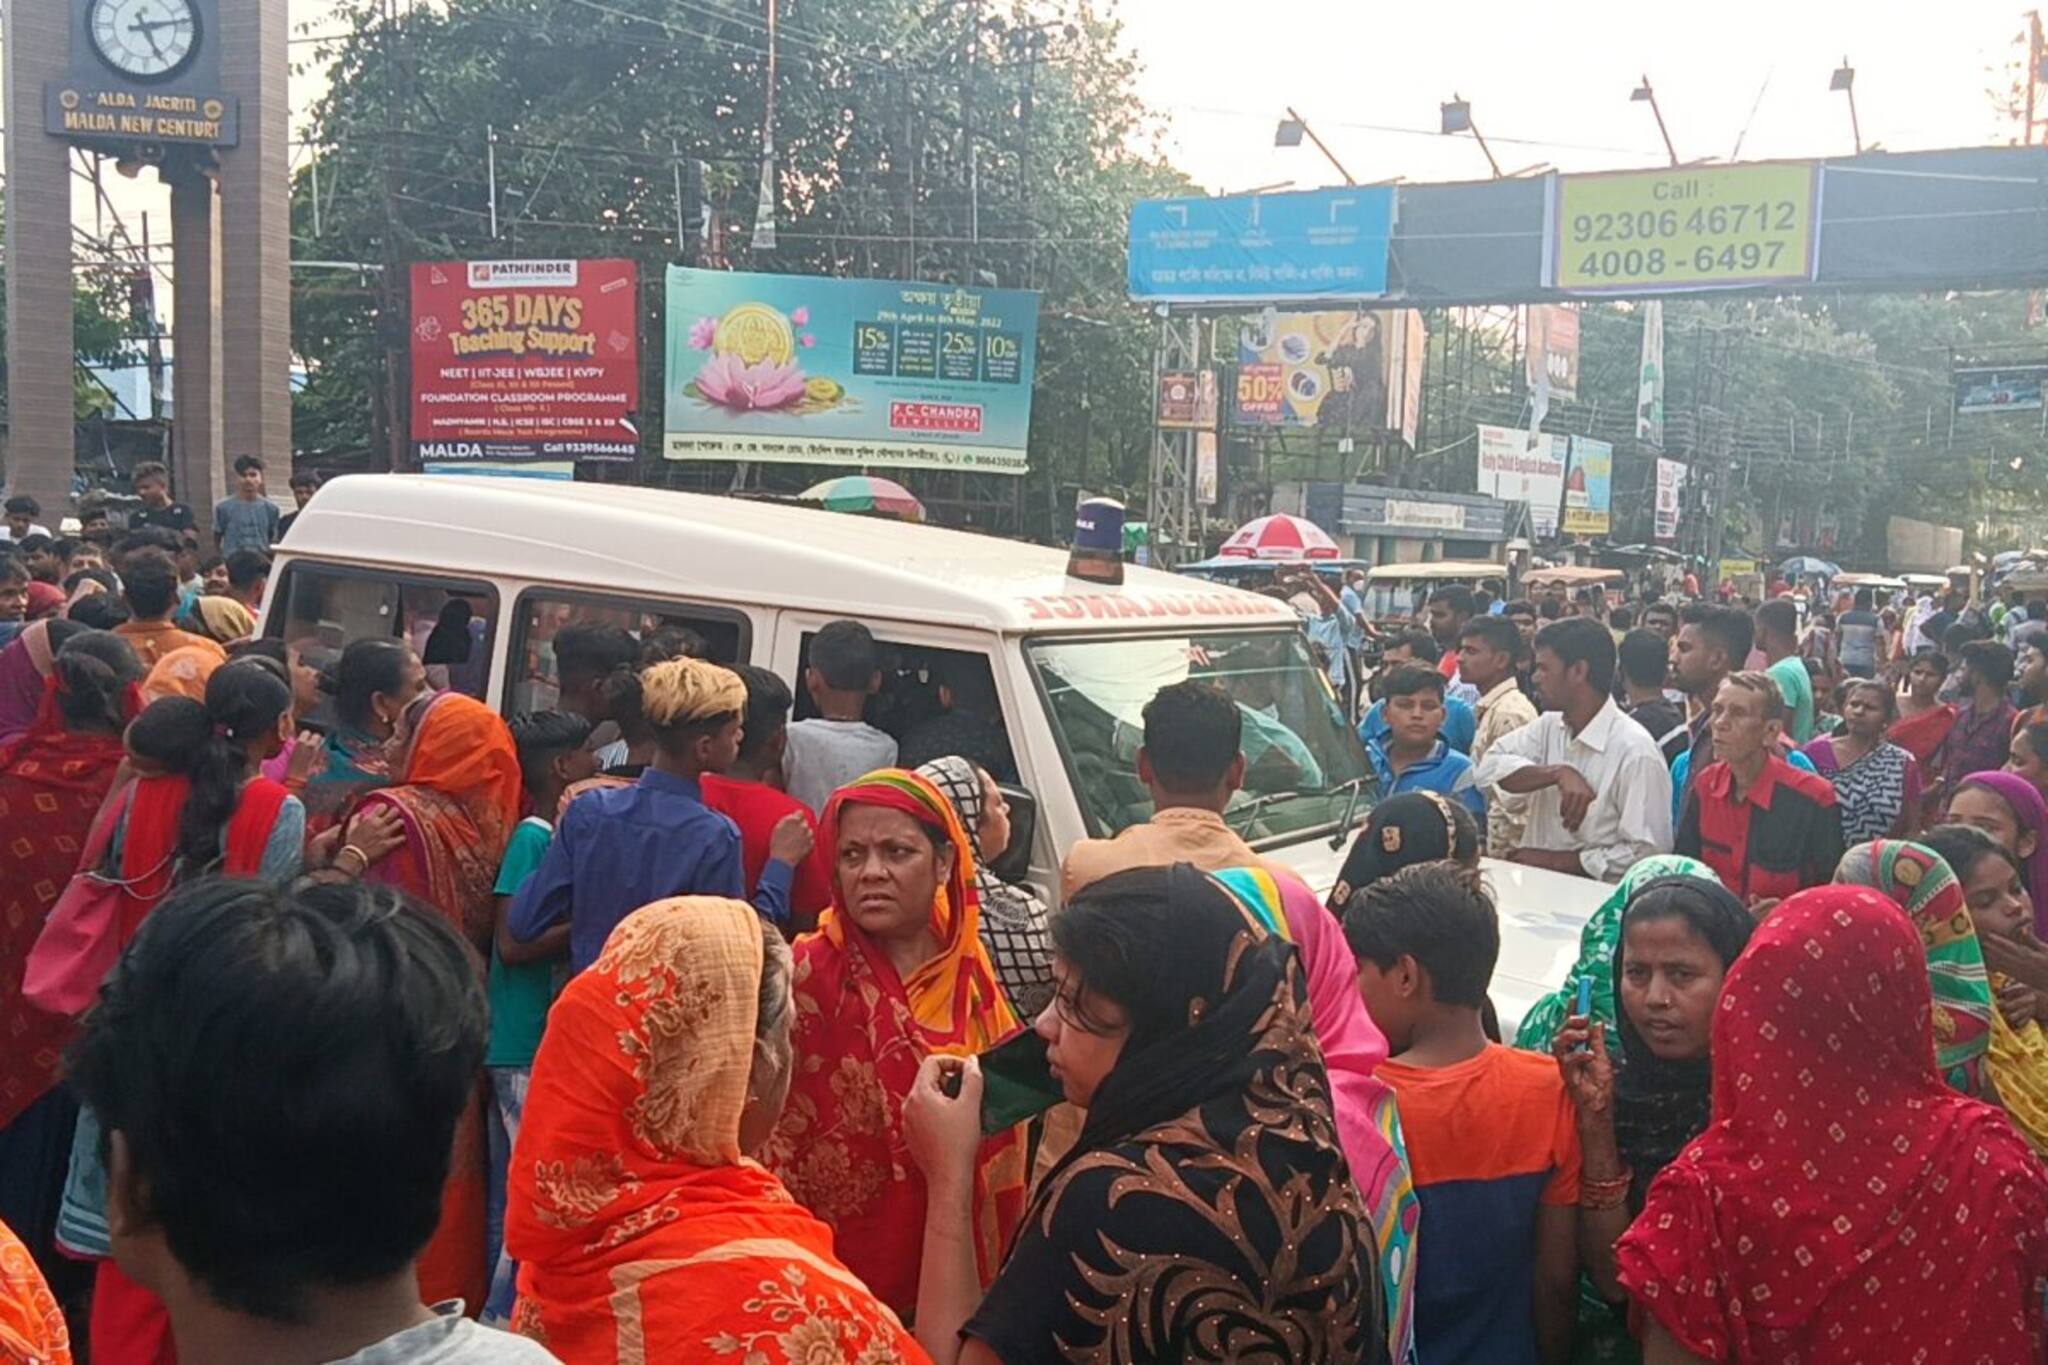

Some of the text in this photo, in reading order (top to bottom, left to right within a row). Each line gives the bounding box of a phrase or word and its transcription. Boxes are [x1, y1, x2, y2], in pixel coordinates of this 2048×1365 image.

[65, 111, 116, 132] MALDA
[120, 115, 153, 134] NEW
[1653, 180, 1699, 201] Call
[492, 263, 572, 275] PATHFINDER
[1578, 249, 1666, 277] 4008
[1693, 241, 1785, 272] 6497
[461, 294, 584, 330] 365 DAYS
[448, 325, 596, 355] Teaching Support
[440, 367, 604, 378] NEET IIT-JEE WBJEE KVPY
[420, 393, 627, 403] FOUNDATION CLASSROOM PROGRAMME
[1237, 375, 1283, 401] 50%
[920, 405, 978, 420] CHANDRA
[419, 443, 484, 458] MALDA
[543, 443, 564, 453] Call
